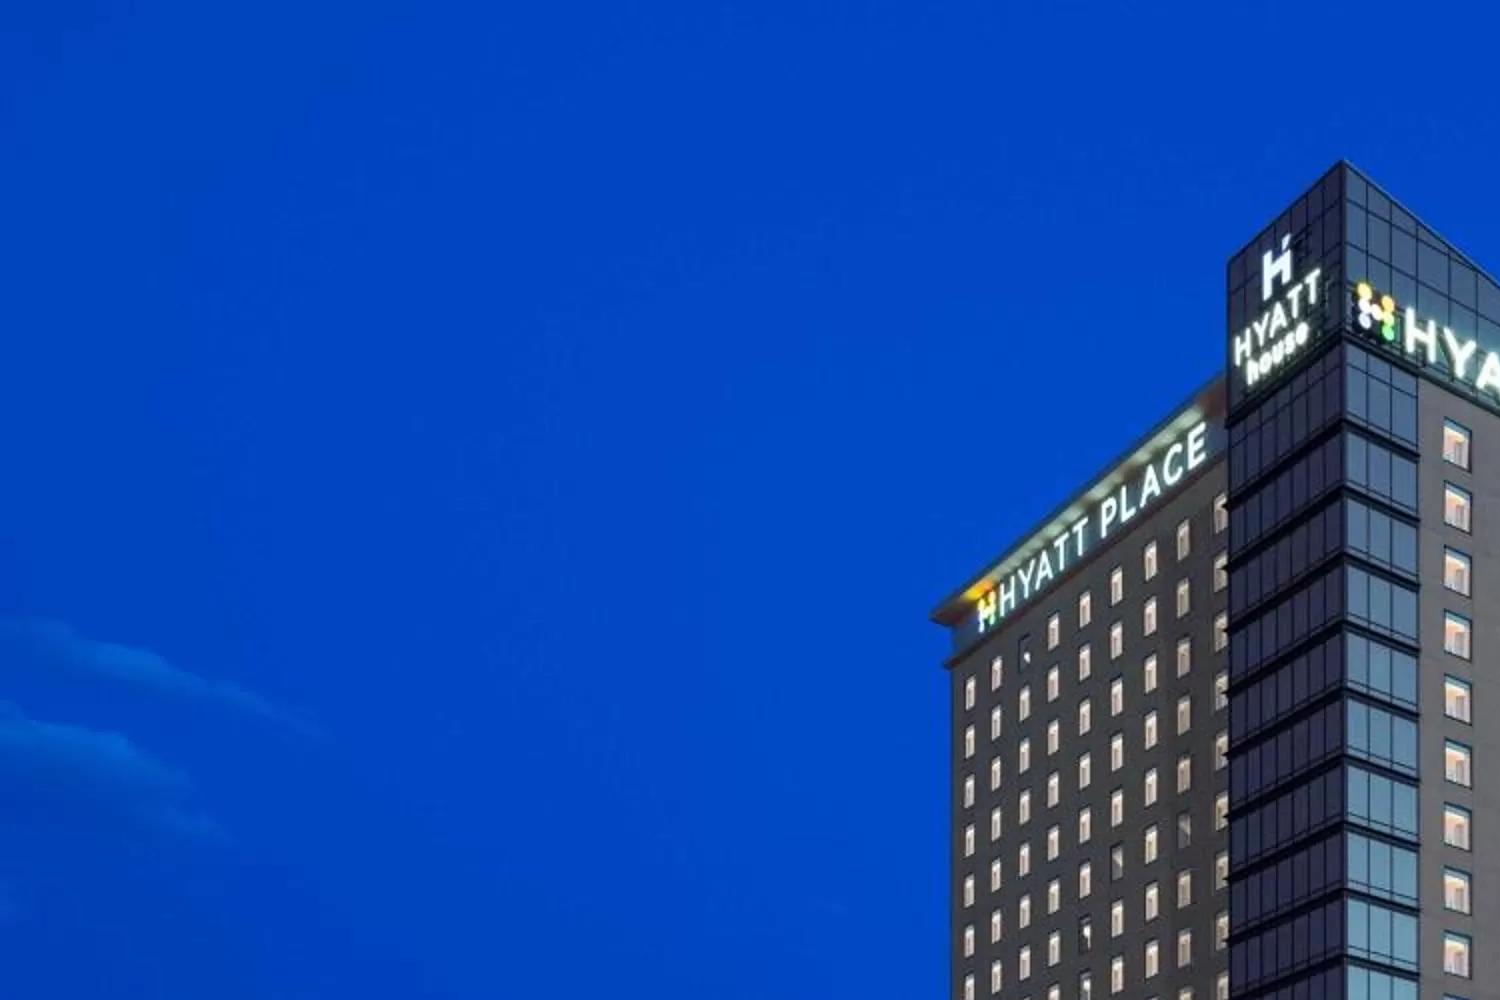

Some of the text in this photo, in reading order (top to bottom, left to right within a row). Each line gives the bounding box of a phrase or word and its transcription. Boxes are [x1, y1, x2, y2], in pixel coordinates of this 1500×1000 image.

[1234, 268, 1322, 366] HYATT
[1246, 321, 1309, 385] house
[998, 517, 1089, 617] HYATT
[1100, 422, 1207, 539] PLACE
